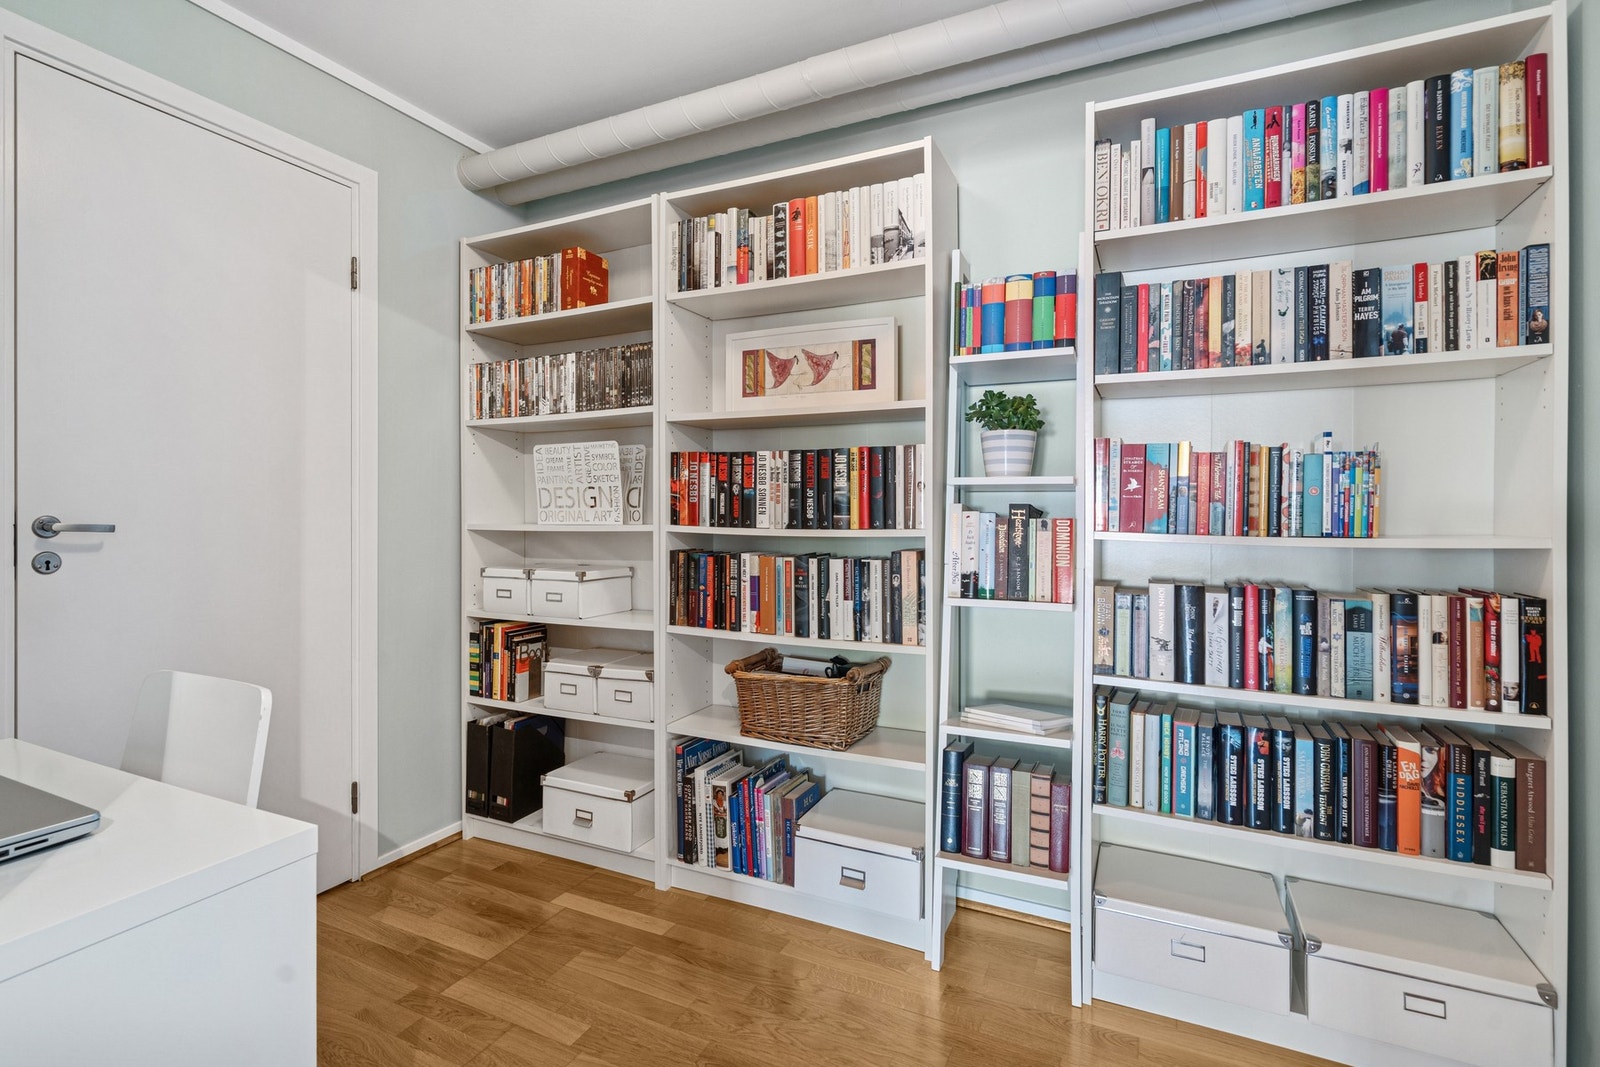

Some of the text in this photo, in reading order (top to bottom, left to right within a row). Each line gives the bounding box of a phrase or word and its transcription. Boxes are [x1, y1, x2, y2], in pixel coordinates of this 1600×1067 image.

[1435, 125, 1444, 151] ELVEN
[1251, 137, 1263, 189] ANALFABETEN
[1096, 152, 1109, 223] BEN OKRI
[1498, 264, 1517, 273] Irving
[1499, 254, 1515, 263] John
[1417, 271, 1425, 299] Nick Hornby
[1529, 248, 1549, 308] SOFIES VERDEN
[1354, 294, 1378, 303] PILGRIM
[1312, 305, 1320, 335] PHYSICS
[1354, 312, 1378, 321] HAYES
[535, 447, 544, 474] IDEA
[544, 447, 571, 455] BEAUTY
[573, 444, 584, 484] ARTIST
[584, 445, 592, 484] CREATIVE
[591, 453, 616, 461] SYMBOL
[718, 454, 728, 462] JO
[820, 455, 830, 463] JO
[537, 475, 574, 485] PAINTING
[592, 462, 618, 472] COLOR
[593, 474, 619, 483] SKETCH
[689, 459, 698, 503] JO NESBØ
[834, 452, 847, 487] JO NESBØ
[538, 486, 613, 509] DESIGN
[757, 453, 767, 516] JO NESBØ SØNNEN
[806, 454, 815, 519] MACBETH JO NESBØ
[1157, 469, 1166, 510] SHANTARAM
[539, 510, 611, 522] ORIGINAL ART
[1011, 509, 1026, 548] Heartstone
[998, 523, 1008, 553] Dissolution
[1055, 519, 1071, 567] DOMINION
[730, 558, 738, 597] ANNE HOLT
[1097, 597, 1106, 625] BROWN
[1158, 587, 1166, 634] JOHN IRVING
[1352, 635, 1360, 658] MUCH
[1378, 635, 1388, 672] Helbredelsen
[1098, 718, 1107, 779] HARRY POTTER
[1177, 728, 1185, 756] FATLAND
[1179, 765, 1187, 794] GRENSEN
[1229, 755, 1237, 807] STIEG LARSSON
[1317, 742, 1331, 793] JOHN GRISHAM
[1399, 770, 1420, 782] DAG
[1400, 760, 1416, 771] EN
[1257, 758, 1265, 811] STIEG LARSSON
[1282, 756, 1291, 810] STIEG LARSSON
[1319, 793, 1328, 826] TESTAMENT
[1455, 777, 1465, 844] MIDDLESEX
[1500, 781, 1508, 846] SEBASTIAN FAULKS
[1526, 761, 1535, 844] Margaret Atwood Alias Grace
